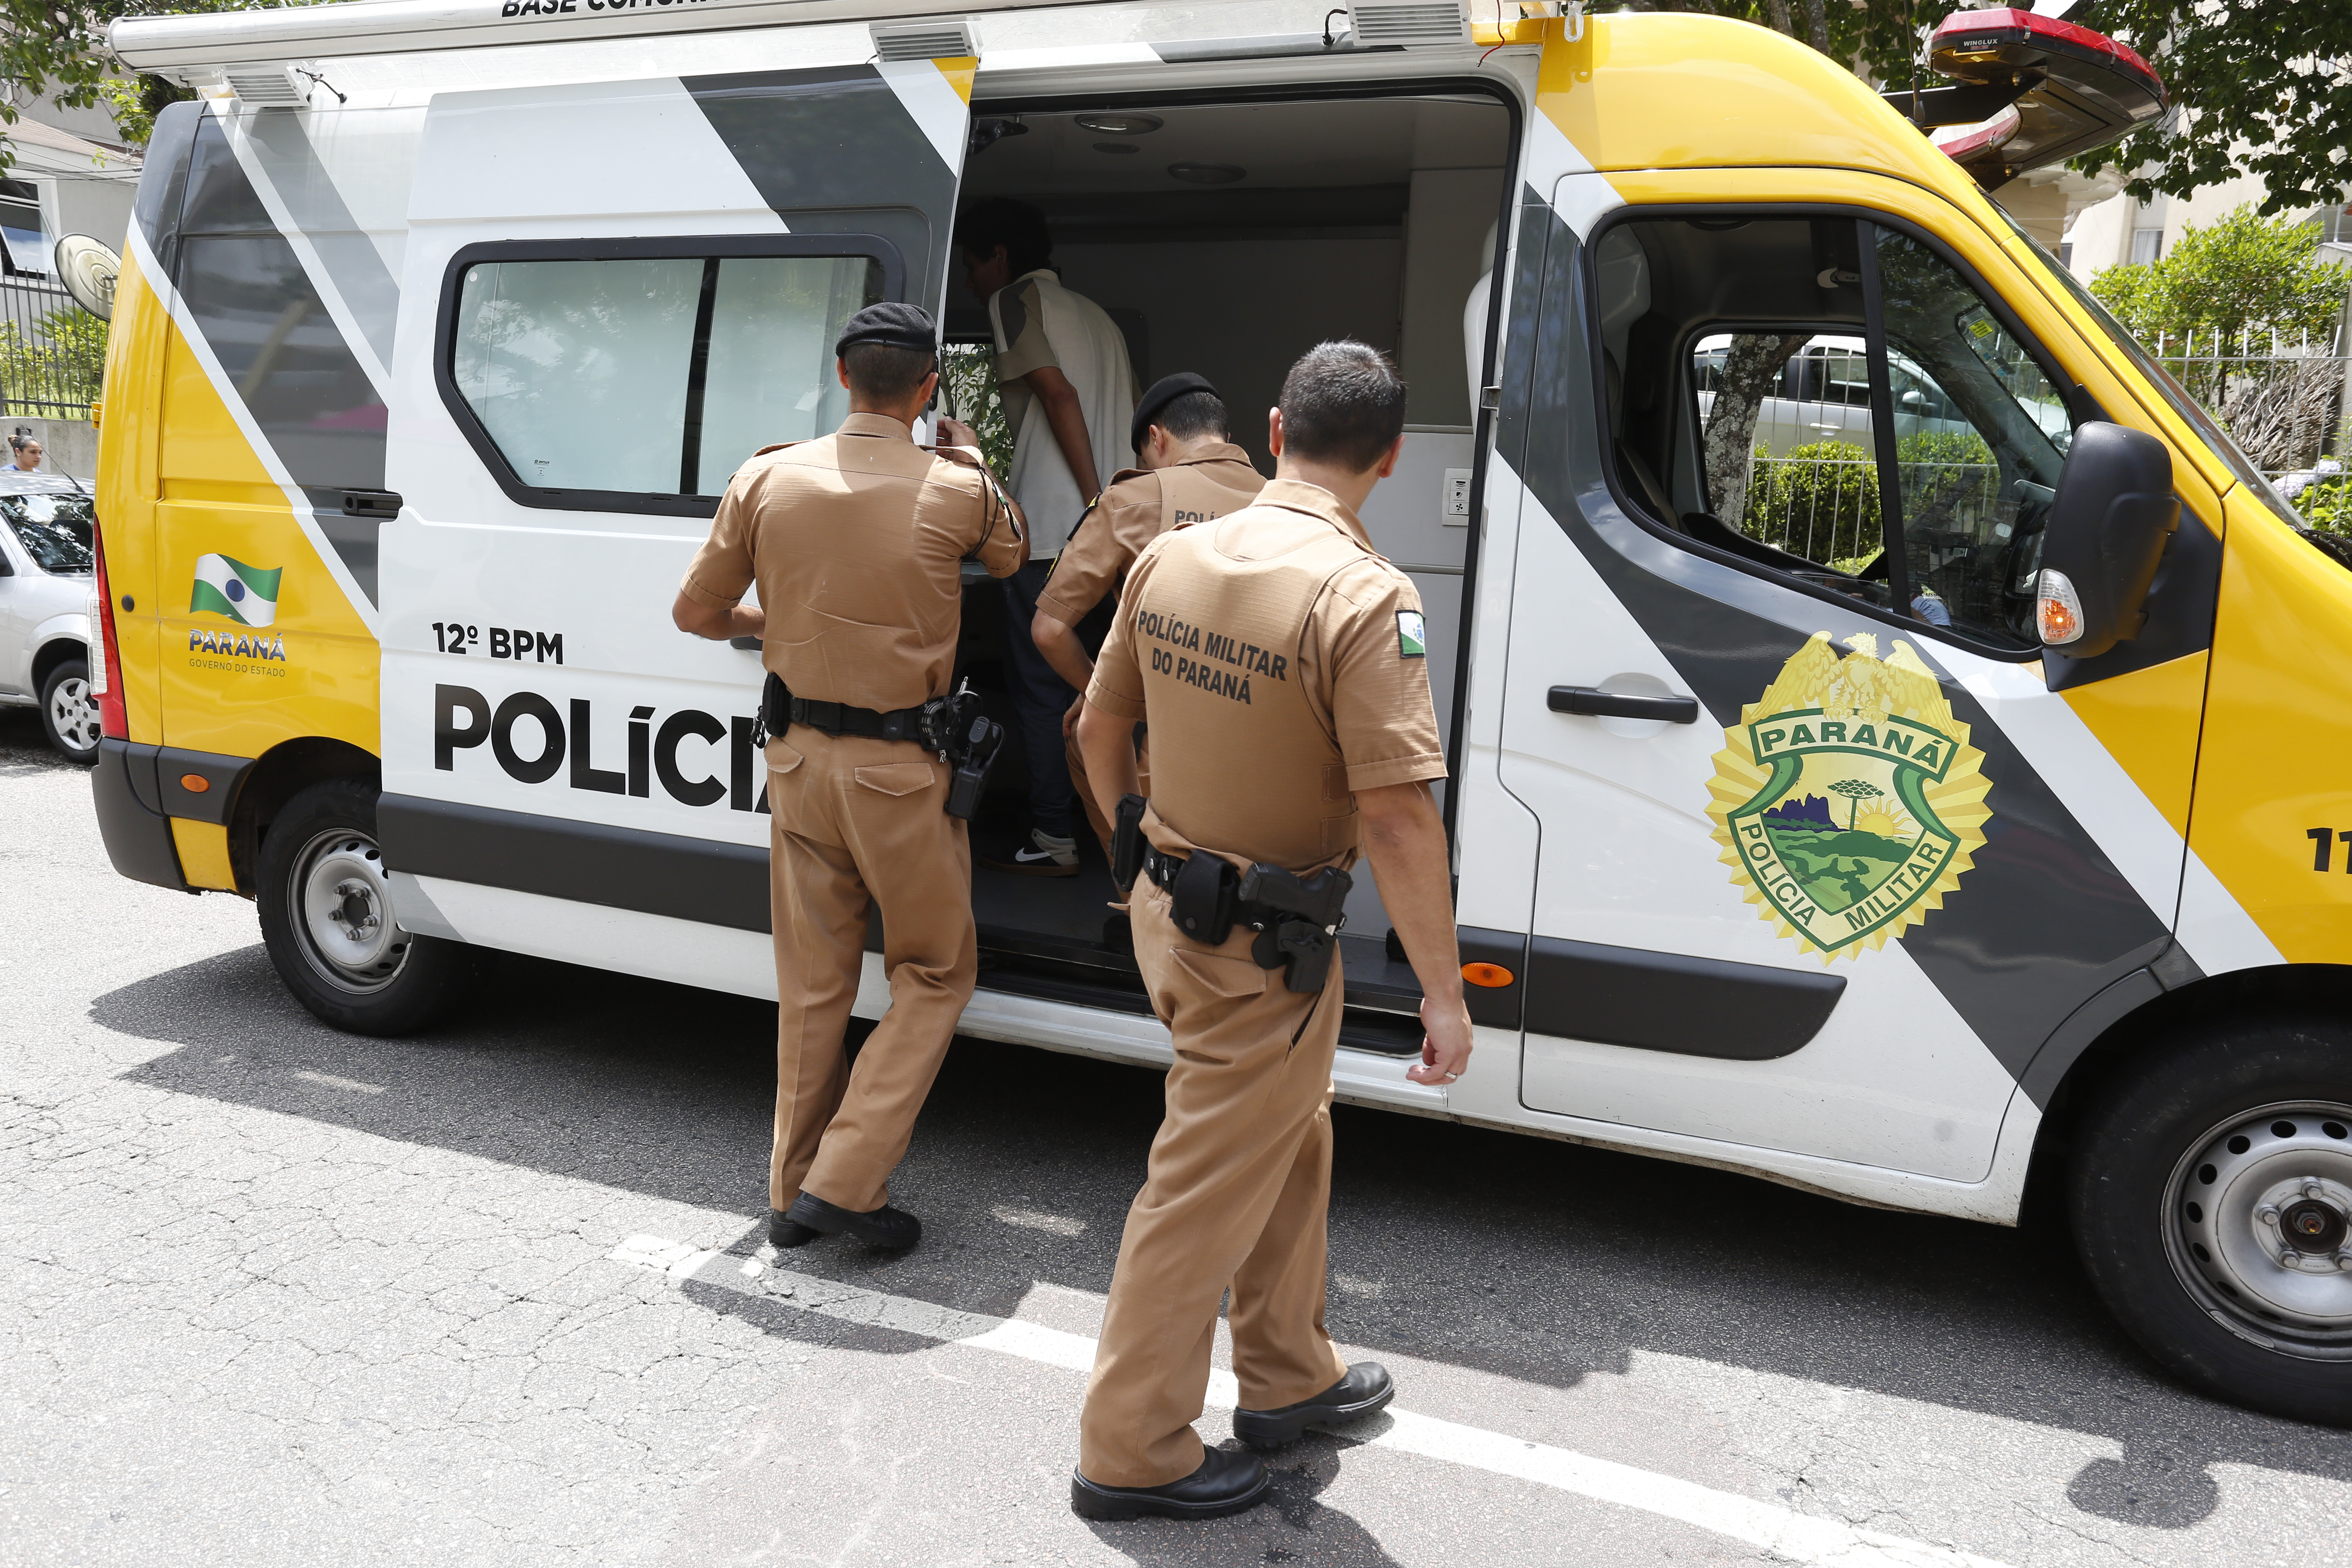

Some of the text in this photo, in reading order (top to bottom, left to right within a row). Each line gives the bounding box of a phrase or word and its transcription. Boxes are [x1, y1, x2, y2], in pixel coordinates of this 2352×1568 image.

[189, 628, 286, 662] PARANÁ
[235, 664, 248, 673] DO
[251, 666, 285, 677] ESTADO
[490, 627, 563, 664] BPM
[1138, 610, 1287, 681] POLÍCIA MILITAR
[1152, 648, 1251, 705] DO PARANÁ
[1760, 722, 1944, 769] PARANÁ
[1740, 823, 1817, 927] POLÍCIA
[1844, 843, 1944, 932] MILITAR
